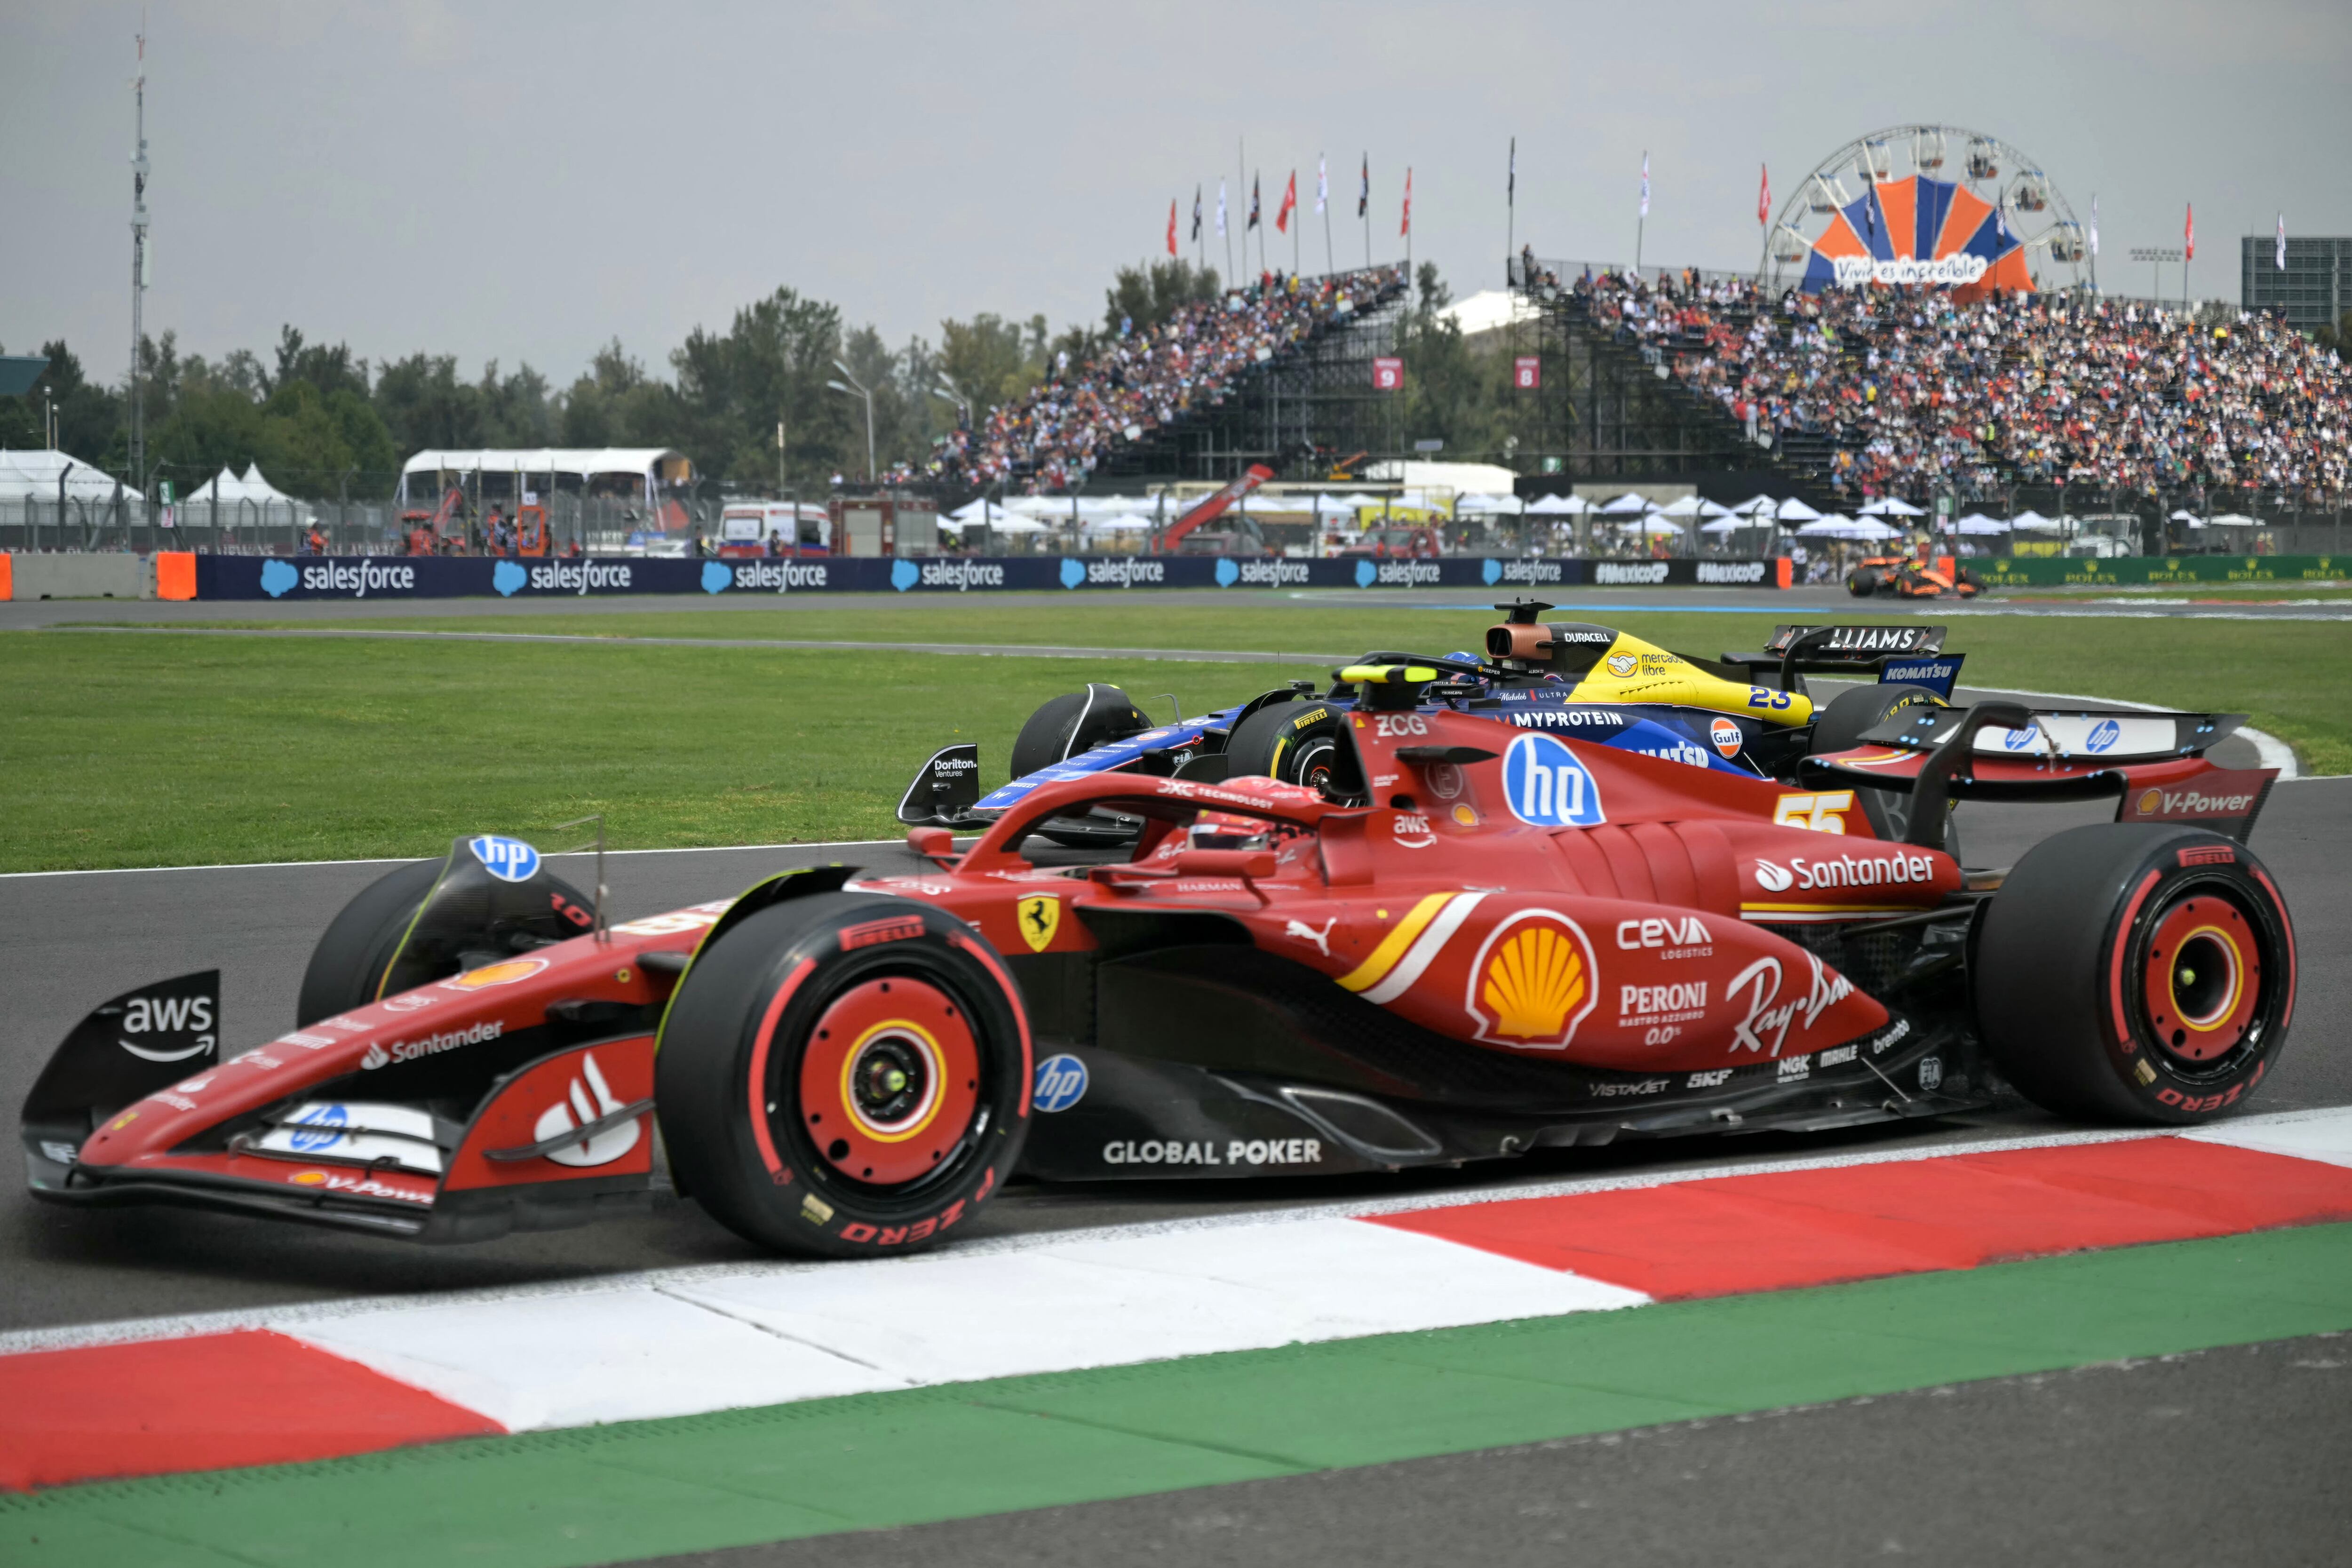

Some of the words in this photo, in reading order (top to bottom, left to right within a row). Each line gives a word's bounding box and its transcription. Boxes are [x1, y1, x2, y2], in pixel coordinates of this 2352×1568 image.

[1882, 266, 1895, 279] es
[1381, 370, 1395, 386] 9
[1521, 370, 1533, 386] 8
[303, 559, 414, 597] salesforce
[531, 559, 631, 595] salesforce
[736, 559, 827, 593] salesforce
[922, 559, 1003, 591] salesforce
[1089, 558, 1164, 589] salesforce
[1241, 558, 1309, 588] salesforce
[1379, 558, 1440, 587] salesforce
[1503, 558, 1561, 586] salesforce
[1596, 563, 1669, 584] #MexicoGP
[1697, 562, 1765, 582] #MexicoGP
[2065, 573, 2117, 584] ROLEX
[2148, 570, 2197, 581] ROLEX
[2228, 569, 2274, 581] ROLEX
[2303, 569, 2345, 580] ROLEX
[1565, 633, 1611, 643] DURACELL
[1803, 629, 1915, 649] LLIAMS
[1642, 664, 1666, 676] libre
[1886, 663, 1952, 680] KOMATSU
[1498, 692, 1527, 701] Michelob
[1748, 686, 1792, 710] 23
[1294, 708, 1327, 729] PIRELLI
[1515, 711, 1623, 728] MYPROTEIN
[1714, 731, 1740, 745] Gulf
[2088, 720, 2119, 753] hp
[1514, 734, 1587, 825] hp
[1198, 786, 1274, 809] TECHNOLOGY
[2162, 792, 2253, 815] V-Power
[1393, 814, 1431, 834] aws
[1773, 791, 1854, 835] 55
[482, 836, 529, 881] hp
[2177, 845, 2235, 868] PIRELLI
[1790, 851, 1934, 890] Santander
[1177, 883, 1241, 892] HARMAN
[838, 915, 926, 951] PIRELLI
[1661, 947, 1713, 960] LOGISTICS
[1620, 981, 1708, 1015] PERONI
[123, 996, 212, 1033] aws
[1661, 1011, 1704, 1024] AZZURRO
[391, 1020, 503, 1064] Santander
[1873, 1019, 1910, 1054] brembo
[1778, 1055, 1810, 1075] NGK
[1820, 1045, 1858, 1067] MAHLE
[1036, 1055, 1085, 1111] hp
[1687, 1069, 1733, 1088] SKF
[2157, 1083, 2243, 1112] ZERO
[1104, 1141, 1220, 1164] GLOBAL
[1227, 1139, 1321, 1164] POKER
[840, 1199, 966, 1245] ZERO
